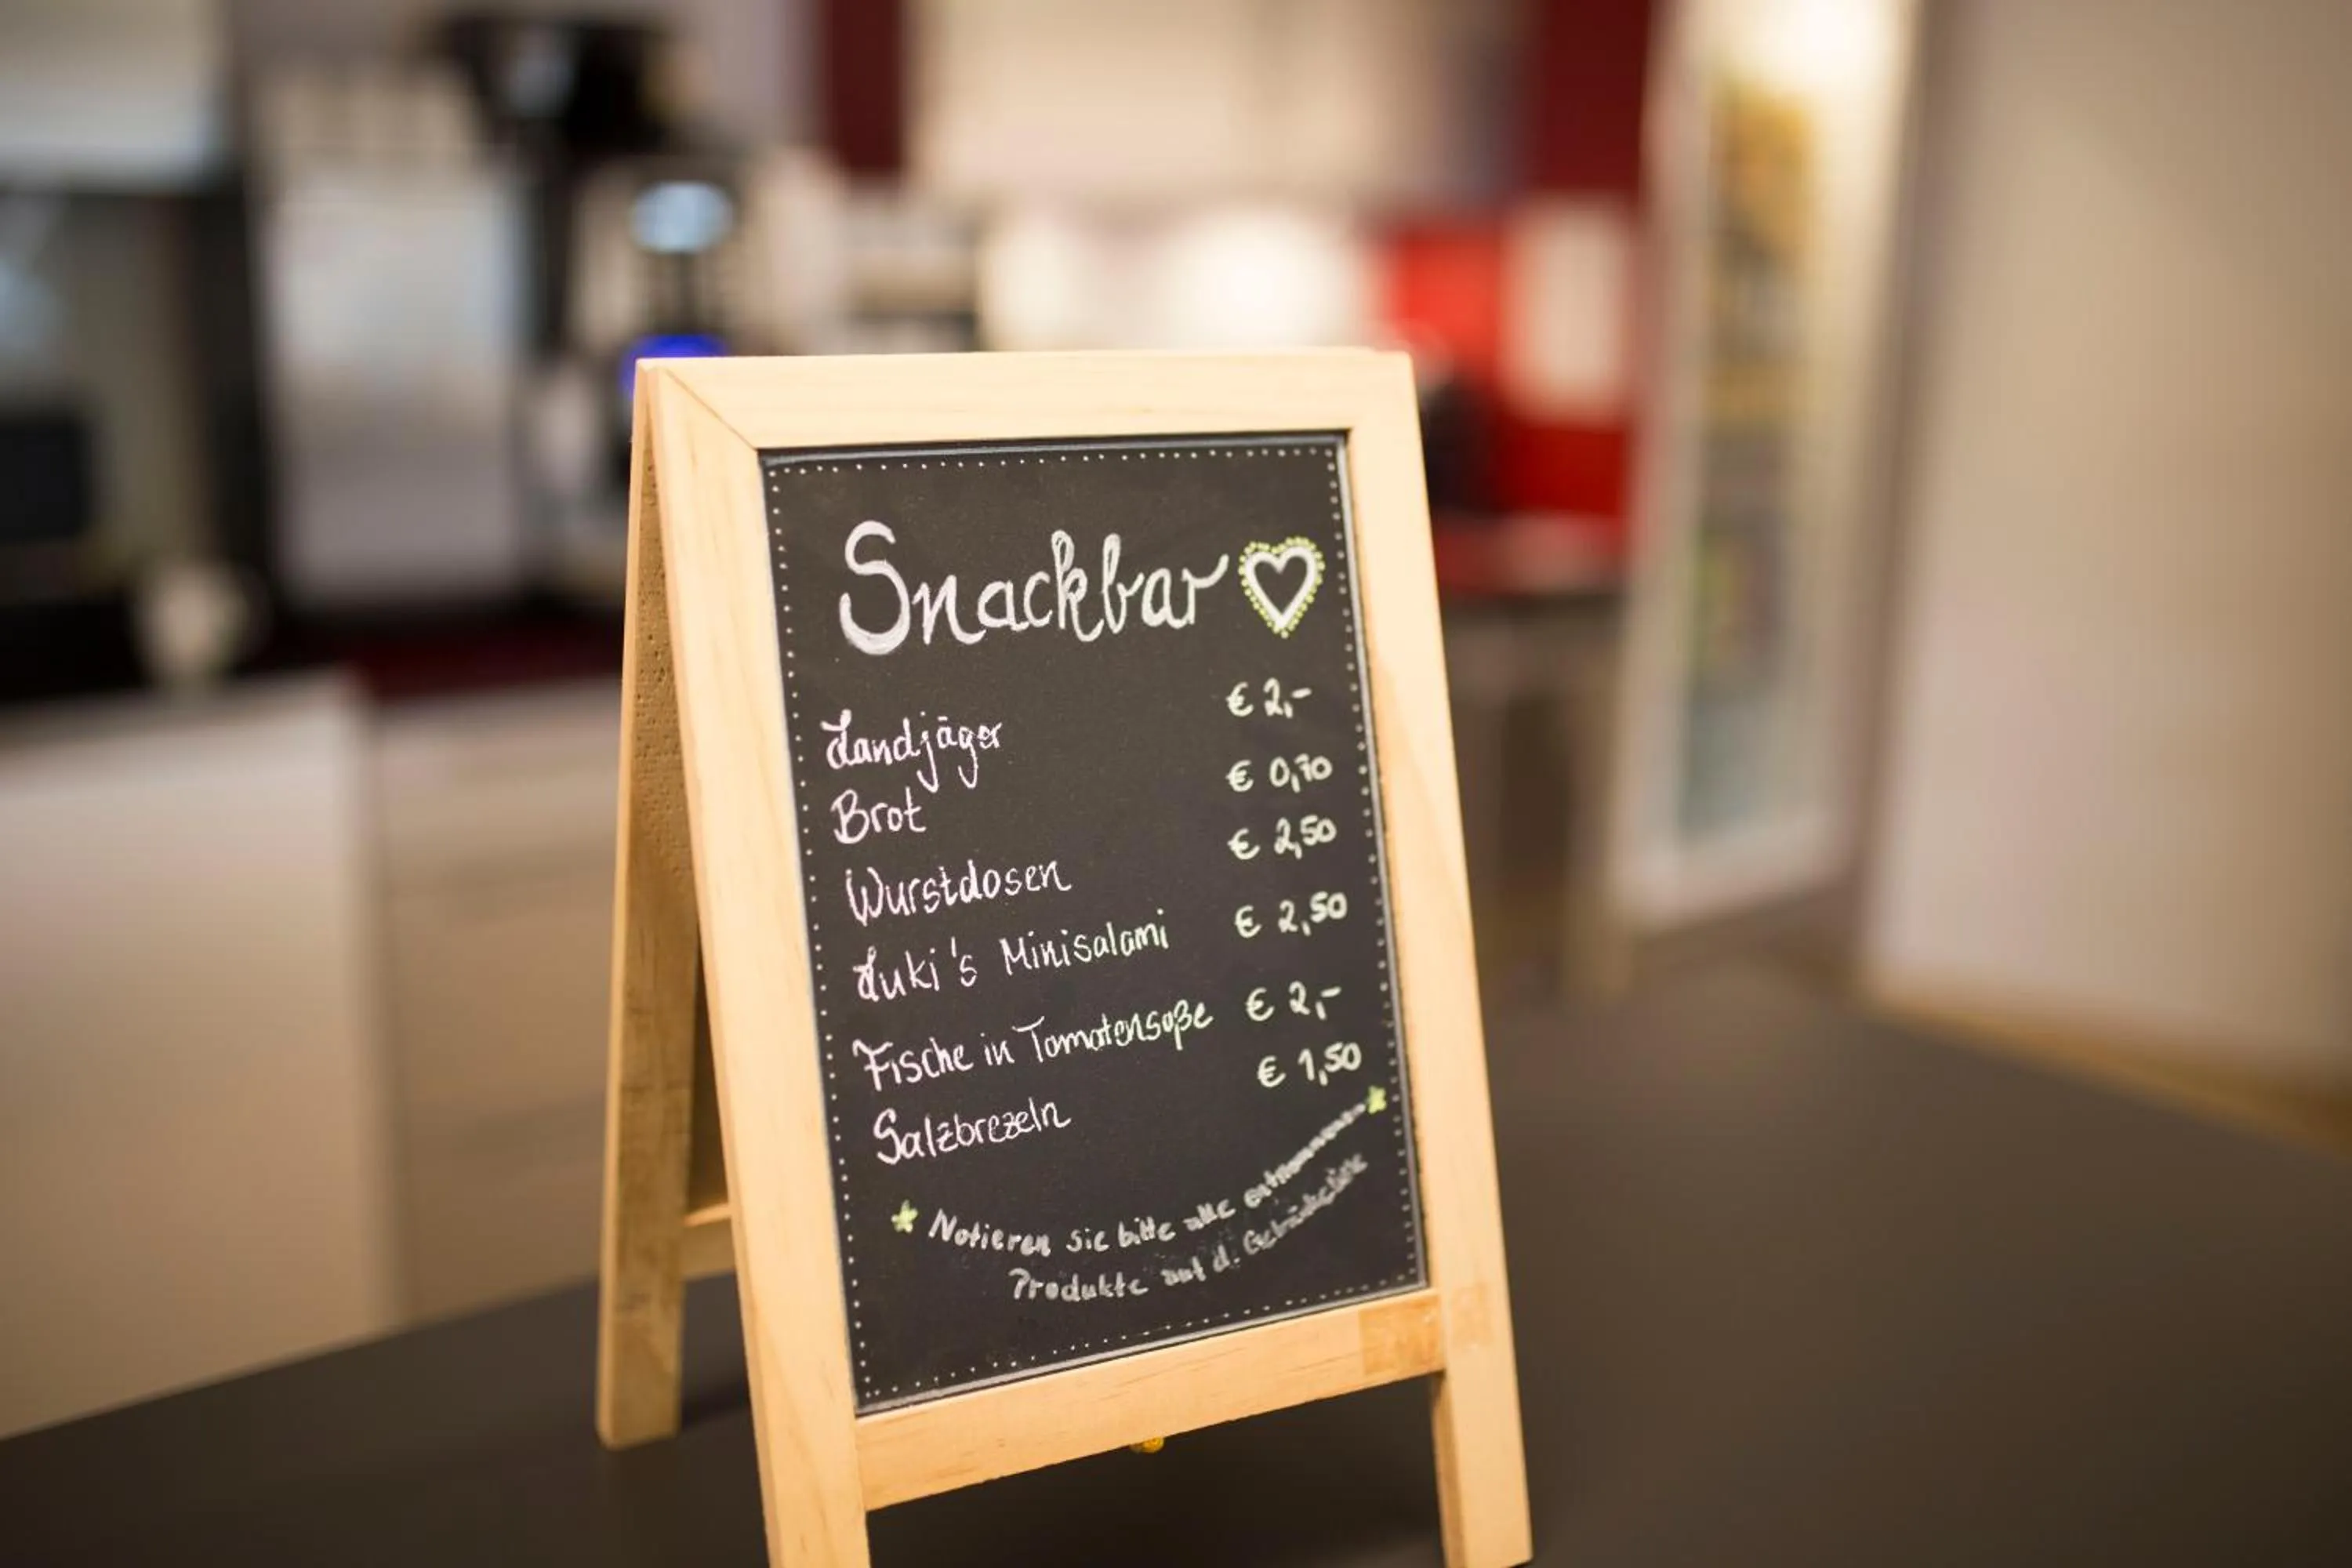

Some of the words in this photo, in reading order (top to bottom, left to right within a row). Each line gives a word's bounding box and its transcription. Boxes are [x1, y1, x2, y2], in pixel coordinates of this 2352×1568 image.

[838, 520, 1230, 656] Snackbar
[819, 708, 1003, 793] Landjäger
[1225, 681, 1254, 717] €
[1263, 677, 1312, 719] 2,-
[829, 786, 927, 844] Brot
[1225, 759, 1254, 793] €
[845, 858, 1073, 927] Wurstdosen
[1227, 827, 1261, 861] €
[1273, 815, 1338, 859] 2,50
[999, 908, 1170, 976] Minisalami
[1234, 905, 1262, 938] €
[1277, 891, 1348, 936] 2,50
[851, 1036, 975, 1092] Fische
[980, 1033, 1015, 1066] in
[1013, 999, 1214, 1063] Tomatensoße
[1245, 987, 1275, 1022] €
[1289, 981, 1341, 1020] 2,-
[873, 1097, 1072, 1165] Salzbrezeln
[1257, 1055, 1287, 1088] €
[1298, 1042, 1362, 1086] 1,50
[927, 1208, 1051, 1258] Notieren
[1118, 1216, 1176, 1248] bitte
[1183, 1200, 1236, 1231] alle
[1008, 1267, 1149, 1302] Produkte
